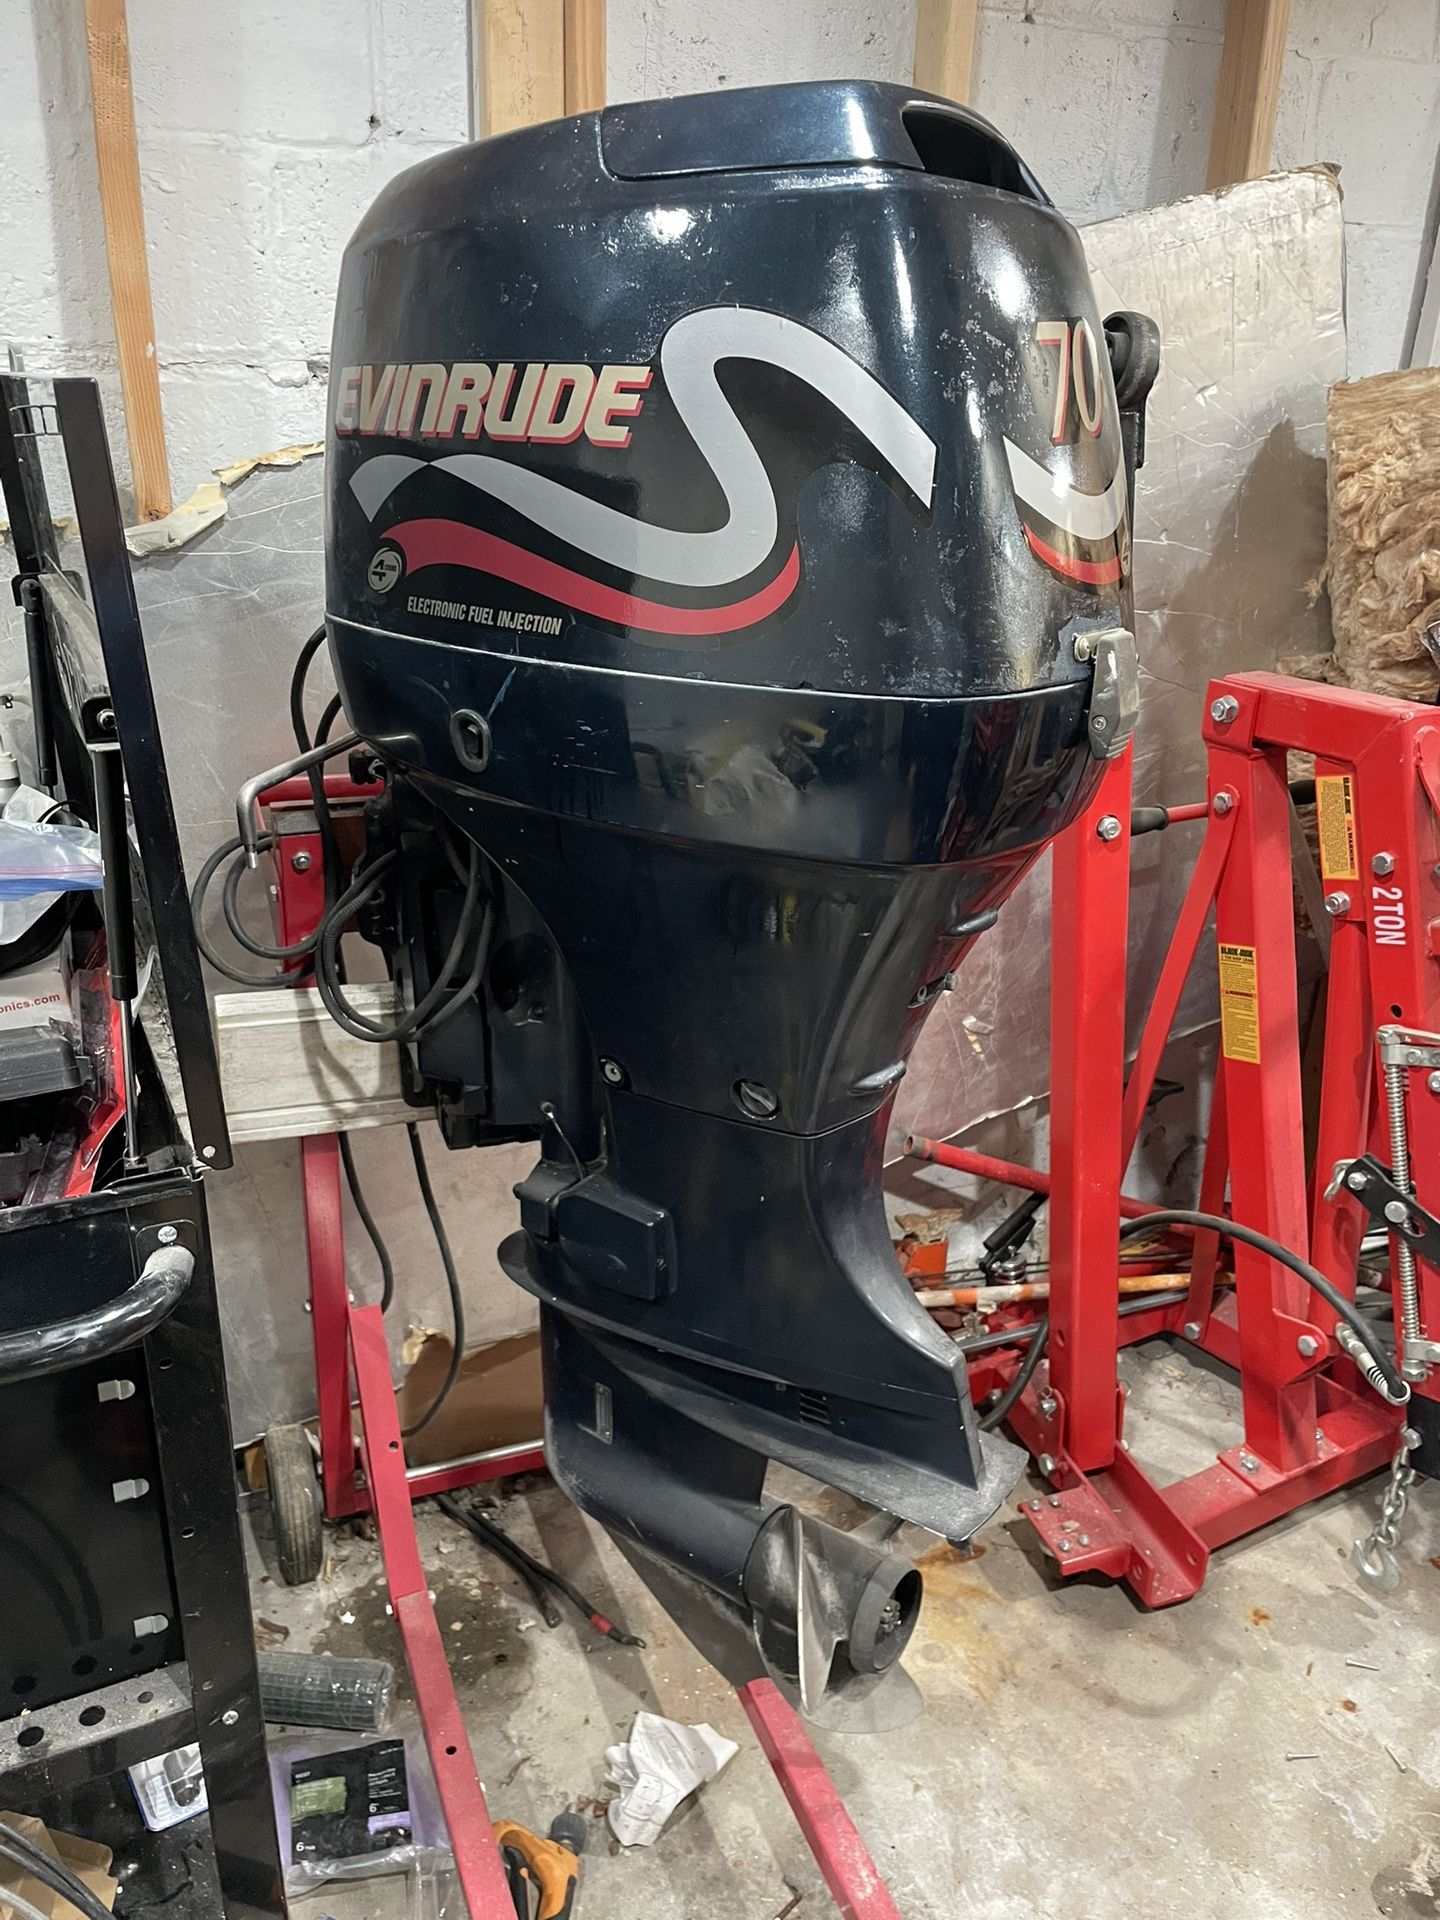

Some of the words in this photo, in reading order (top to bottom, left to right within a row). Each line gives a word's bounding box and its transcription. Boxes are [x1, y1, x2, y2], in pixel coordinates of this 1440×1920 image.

[335, 363, 654, 448] EVINRUDE
[1036, 318, 1103, 443] 70
[407, 596, 466, 620] ELECTRONIC
[468, 605, 494, 626] FUEL
[497, 610, 563, 635] INJECTION
[0, 994, 61, 1013] onics.com
